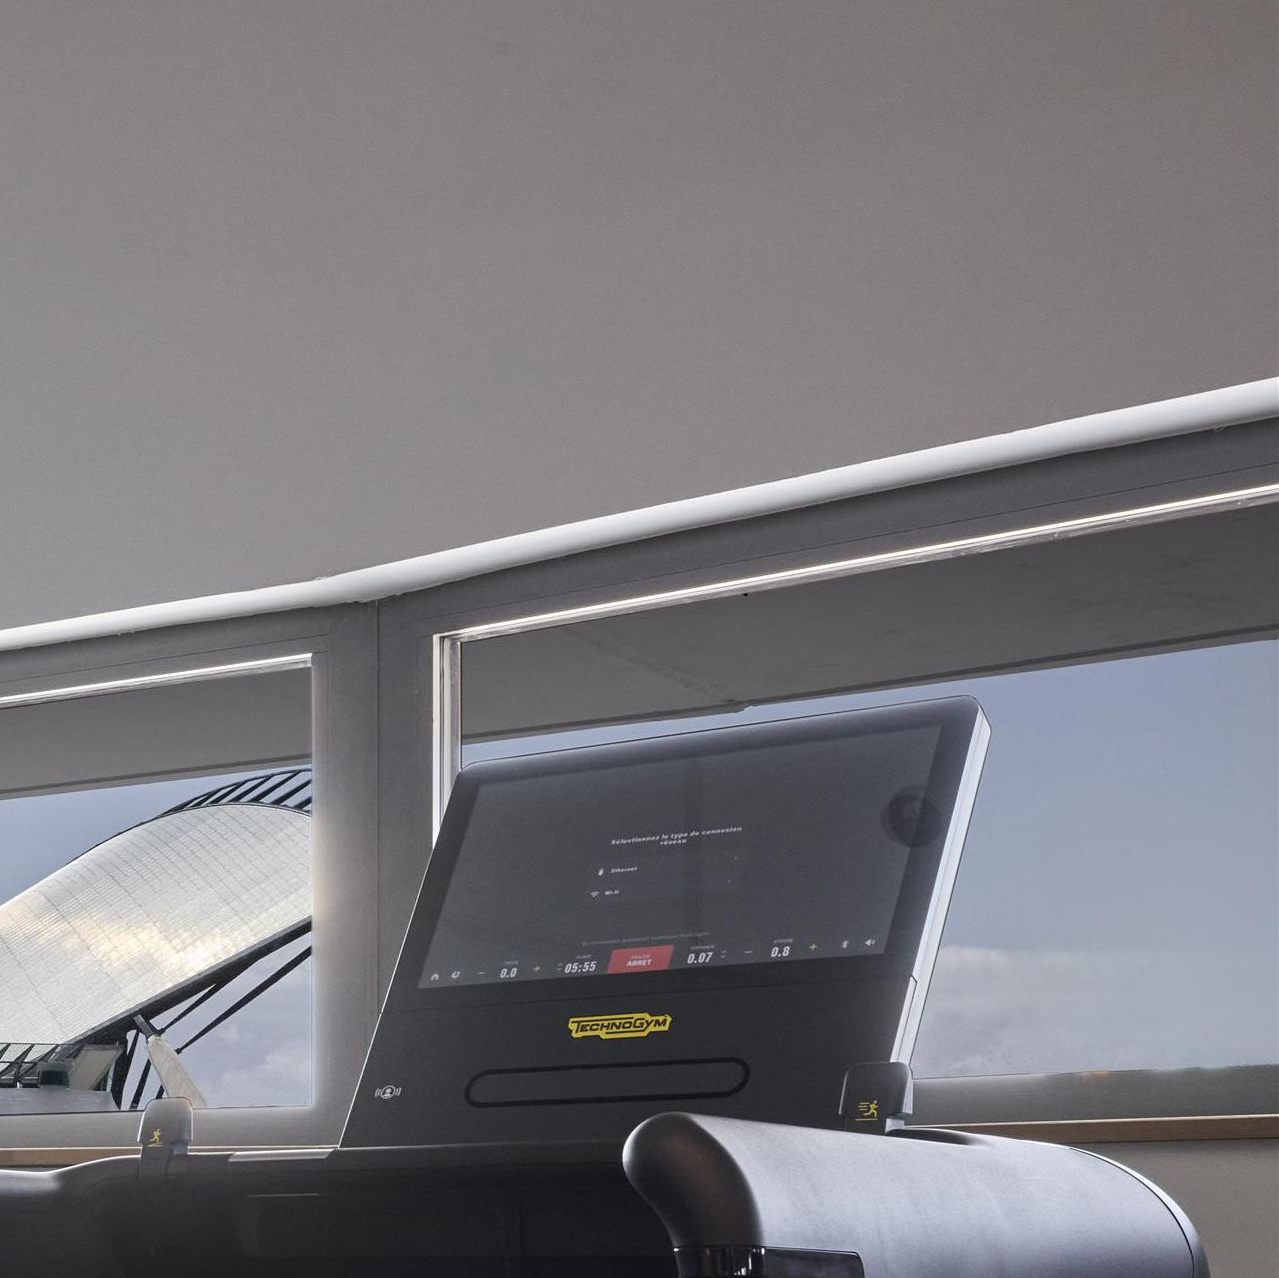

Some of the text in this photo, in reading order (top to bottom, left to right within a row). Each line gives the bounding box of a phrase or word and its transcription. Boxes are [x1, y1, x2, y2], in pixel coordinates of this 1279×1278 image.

[687, 951, 714, 964] 0.07
[770, 945, 791, 958] 0.8
[499, 967, 518, 979] 0.0
[564, 960, 597, 974] 05:55
[570, 1016, 668, 1035] TECHNOGYM
